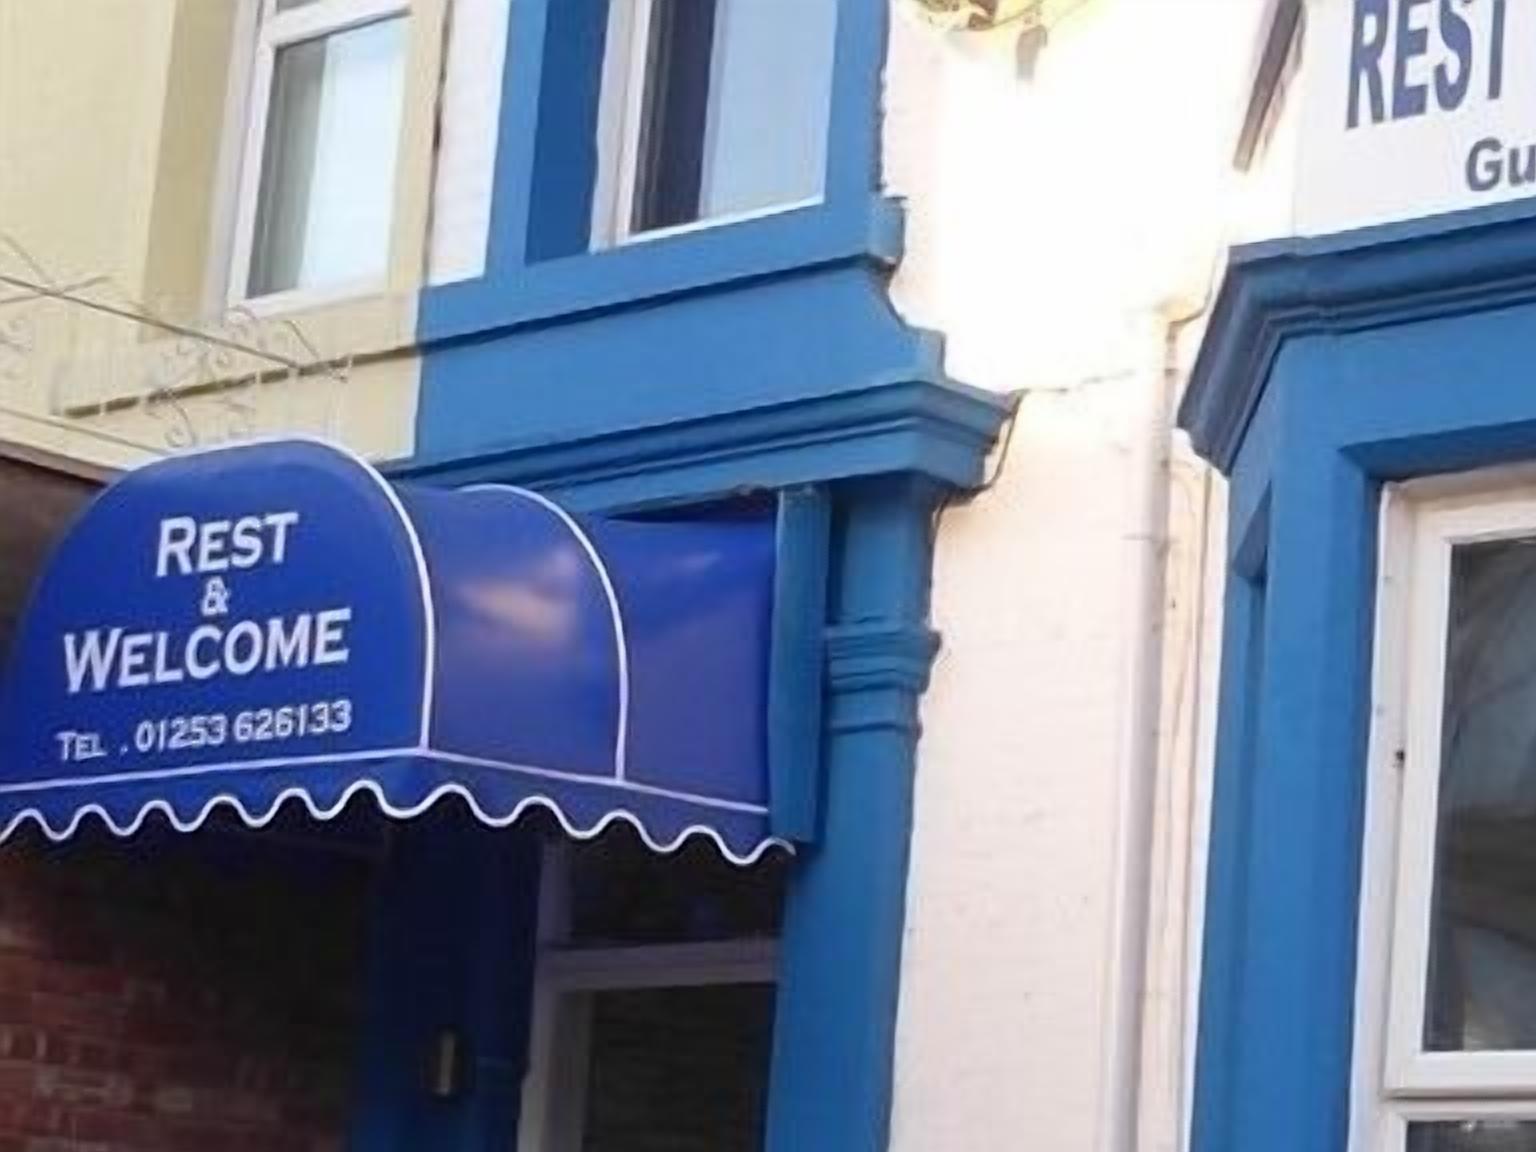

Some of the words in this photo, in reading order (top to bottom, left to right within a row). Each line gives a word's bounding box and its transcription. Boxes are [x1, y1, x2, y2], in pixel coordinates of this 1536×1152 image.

[1346, 0, 1506, 129] REST
[156, 512, 299, 577] REST
[202, 576, 229, 615] &
[64, 607, 351, 694] WELCOME
[234, 699, 352, 742] 626133
